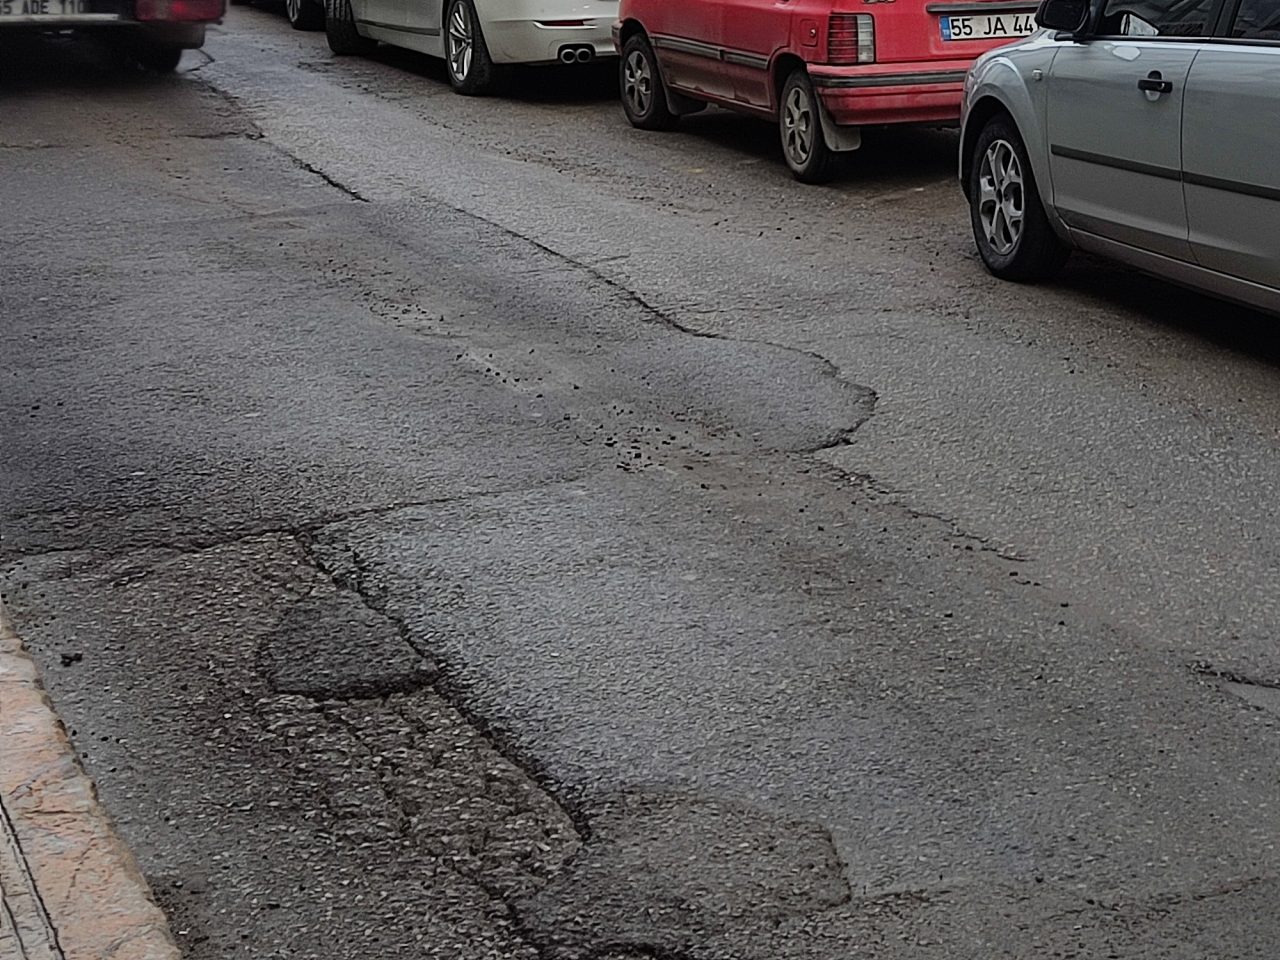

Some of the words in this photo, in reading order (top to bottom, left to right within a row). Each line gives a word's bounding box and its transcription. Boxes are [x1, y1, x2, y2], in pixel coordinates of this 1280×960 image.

[22, 0, 49, 14] ADE
[951, 18, 973, 36] 55
[983, 16, 1007, 35] JA
[1013, 15, 1040, 33] 44
